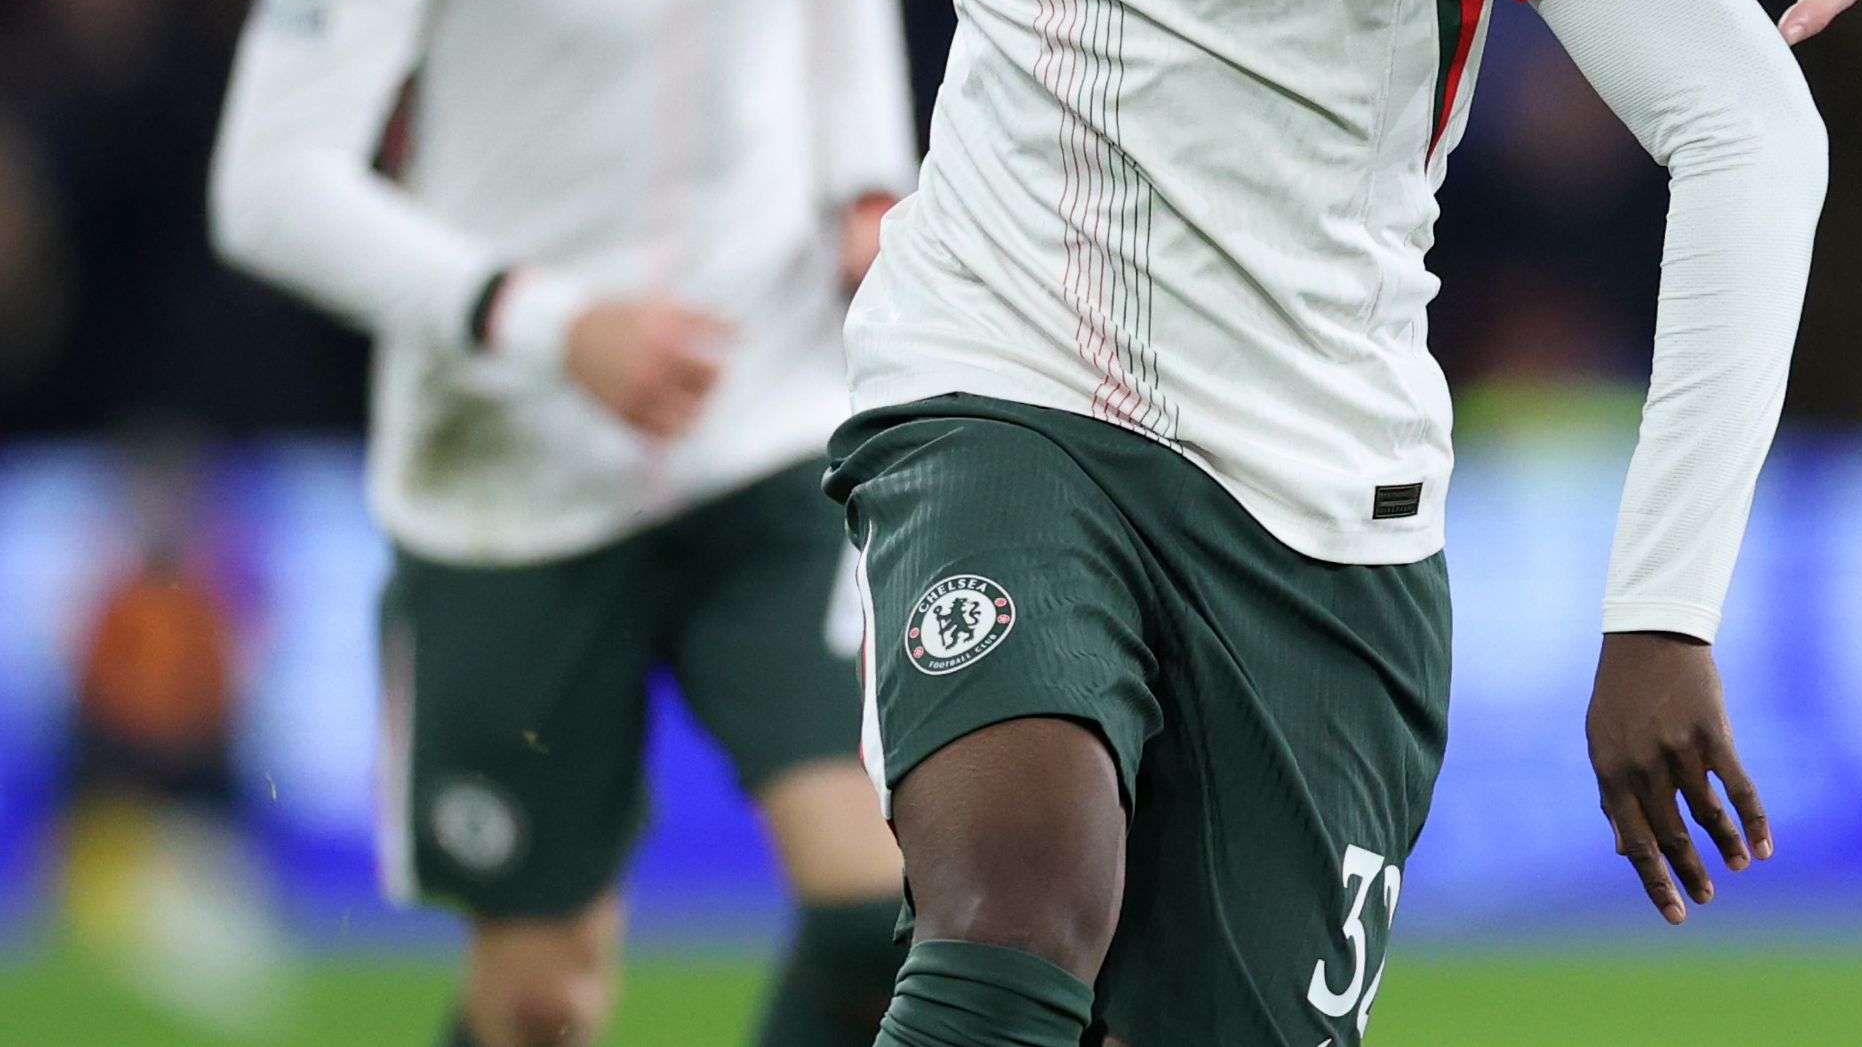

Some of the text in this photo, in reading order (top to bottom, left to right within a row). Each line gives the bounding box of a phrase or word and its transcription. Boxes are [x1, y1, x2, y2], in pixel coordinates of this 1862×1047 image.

[918, 578, 988, 613] CHELSEA
[928, 633, 998, 670] FOOTBALL CLUB
